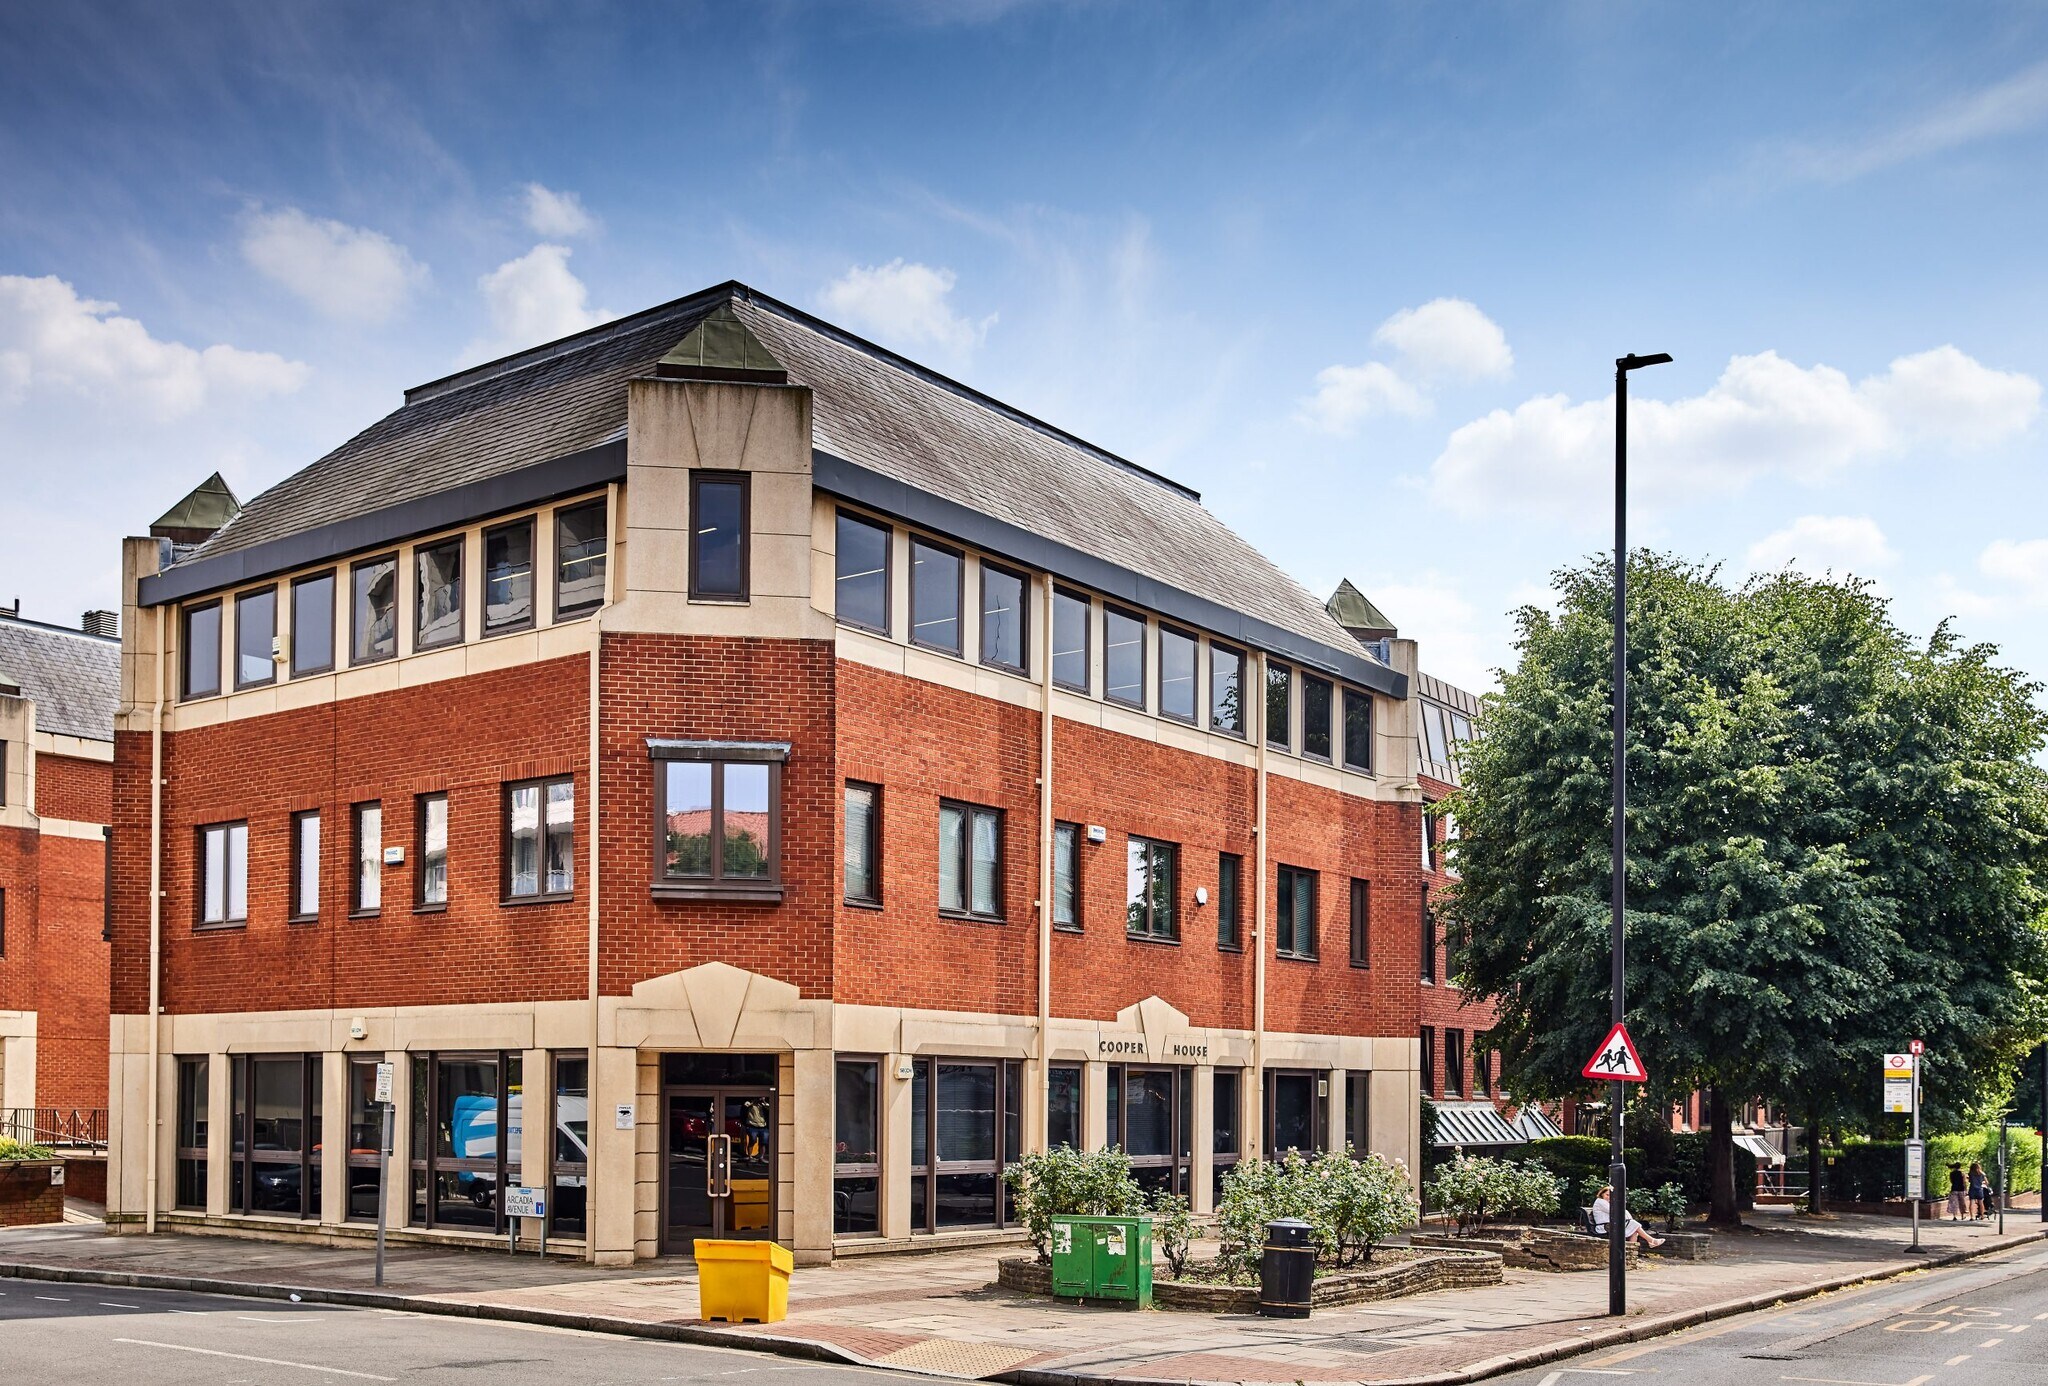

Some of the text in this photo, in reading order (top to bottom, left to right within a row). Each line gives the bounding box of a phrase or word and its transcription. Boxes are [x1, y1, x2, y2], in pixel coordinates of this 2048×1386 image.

[1100, 1041, 1208, 1057] COOPER HOUSE
[1911, 1042, 1922, 1054] H
[507, 1195, 533, 1204] ARCADIA
[507, 1205, 529, 1214] AVENUE
